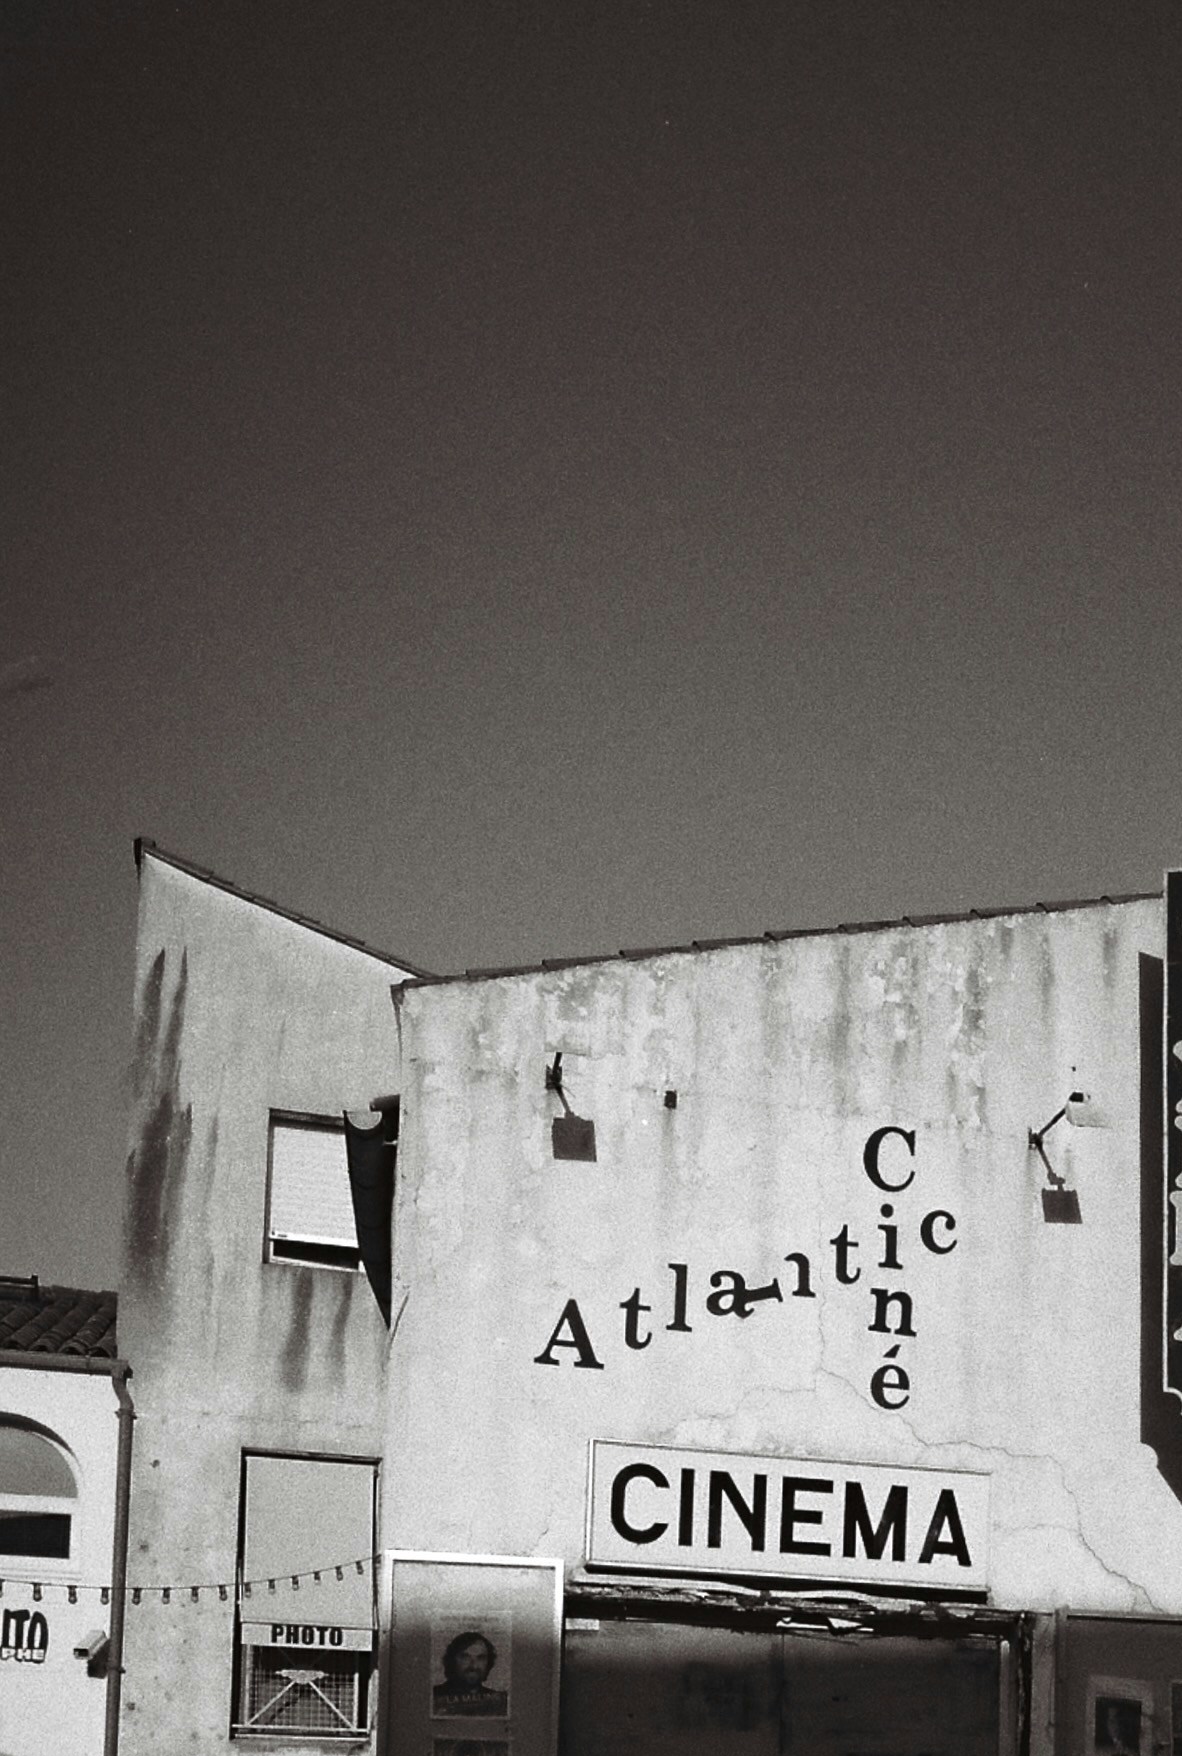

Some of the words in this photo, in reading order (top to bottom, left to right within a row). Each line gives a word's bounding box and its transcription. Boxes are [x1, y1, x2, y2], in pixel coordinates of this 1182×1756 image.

[863, 1126, 917, 1410] Ciné
[610, 1462, 973, 1568] CINEMA
[270, 1624, 343, 1647] PHOTO
